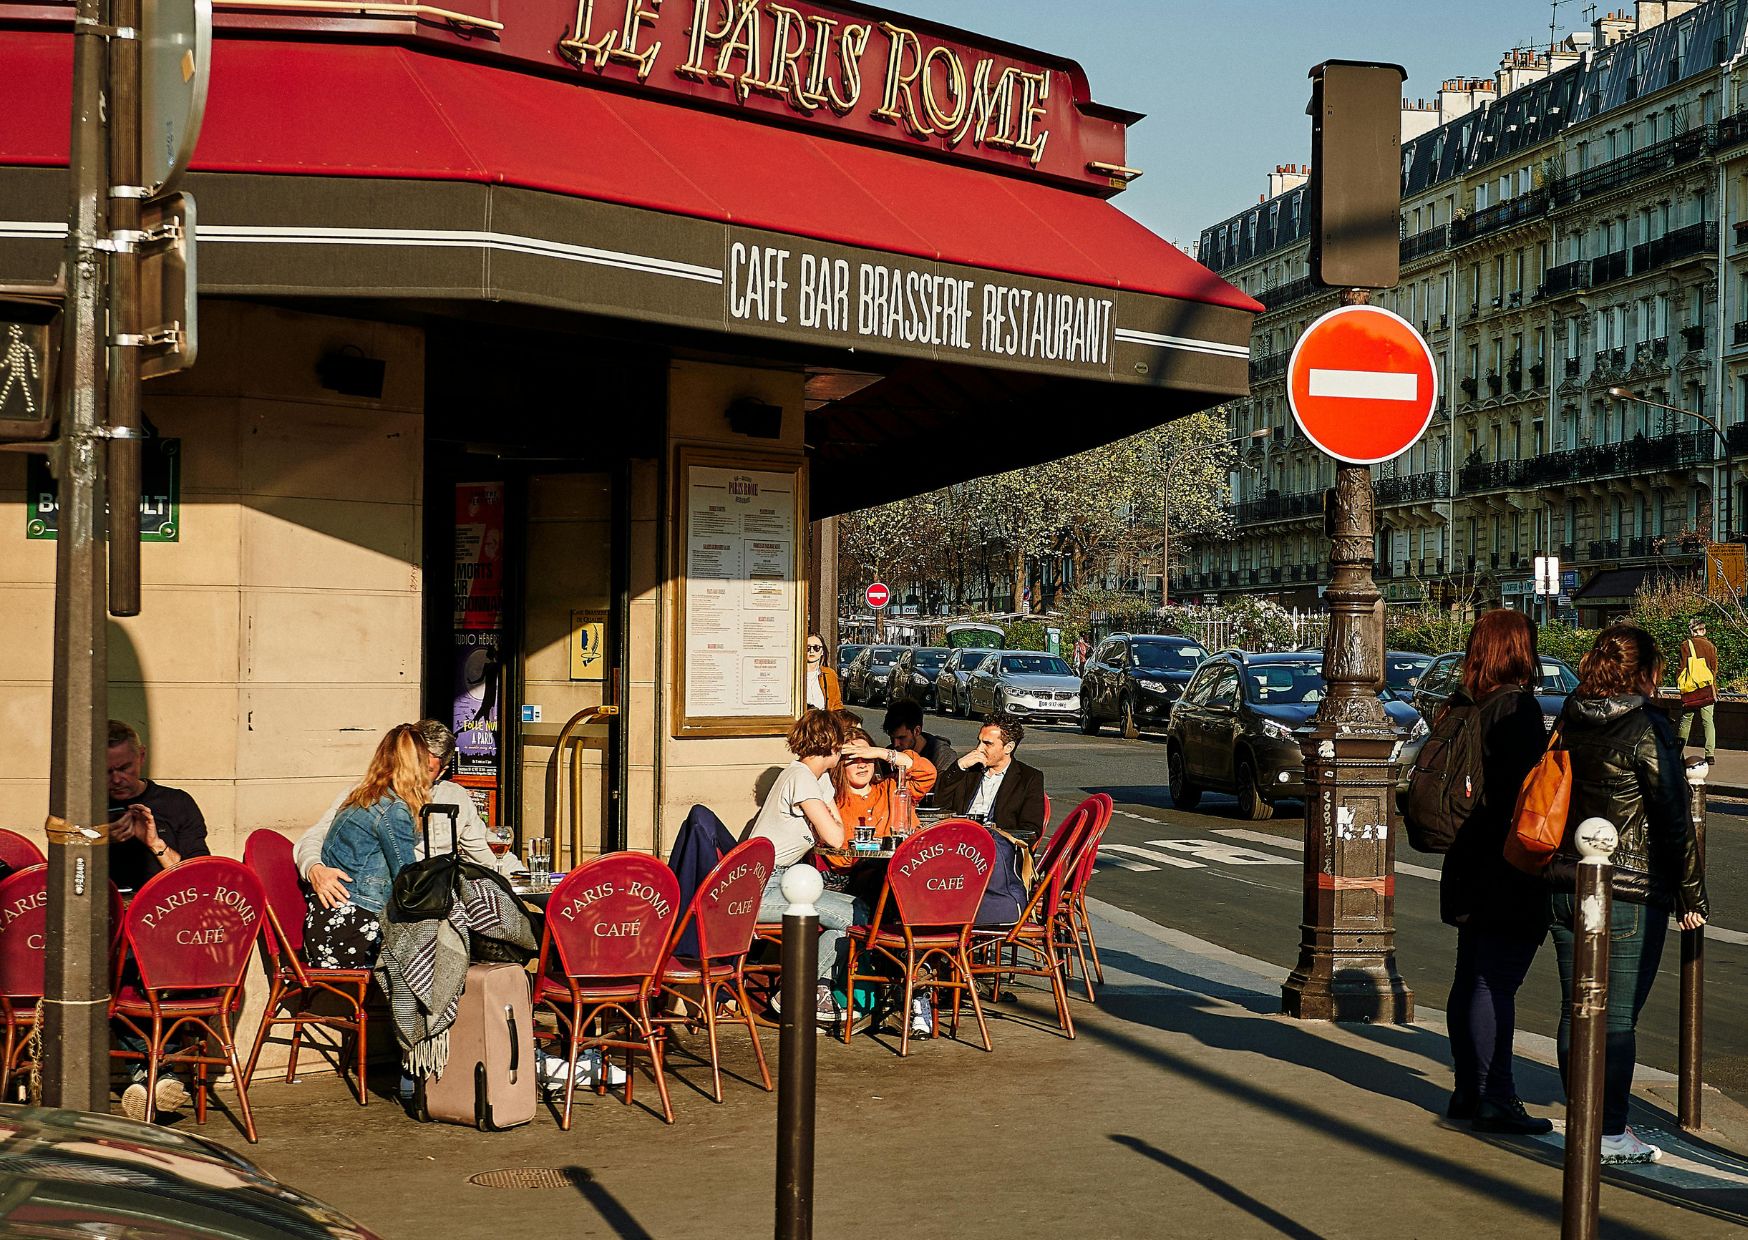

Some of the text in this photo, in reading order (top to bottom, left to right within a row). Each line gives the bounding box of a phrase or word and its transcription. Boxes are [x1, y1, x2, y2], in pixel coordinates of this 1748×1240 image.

[559, 0, 1051, 163] LE PARIS ROME
[730, 242, 1113, 364] CAFE BAR BRASSERIE RESTAURANT
[899, 843, 945, 878] PARIS
[955, 842, 988, 876] ROME
[561, 882, 614, 922] PARIS
[627, 881, 671, 920] ROME
[709, 863, 748, 902] PARIS
[926, 874, 965, 891] CAFÉ
[0, 891, 47, 932] ARIS
[141, 887, 198, 930] PARIS
[213, 886, 256, 926] ROME
[728, 896, 754, 915] CAFÉ
[176, 925, 225, 945] CAFÉ
[594, 918, 641, 937] CAFÉ
